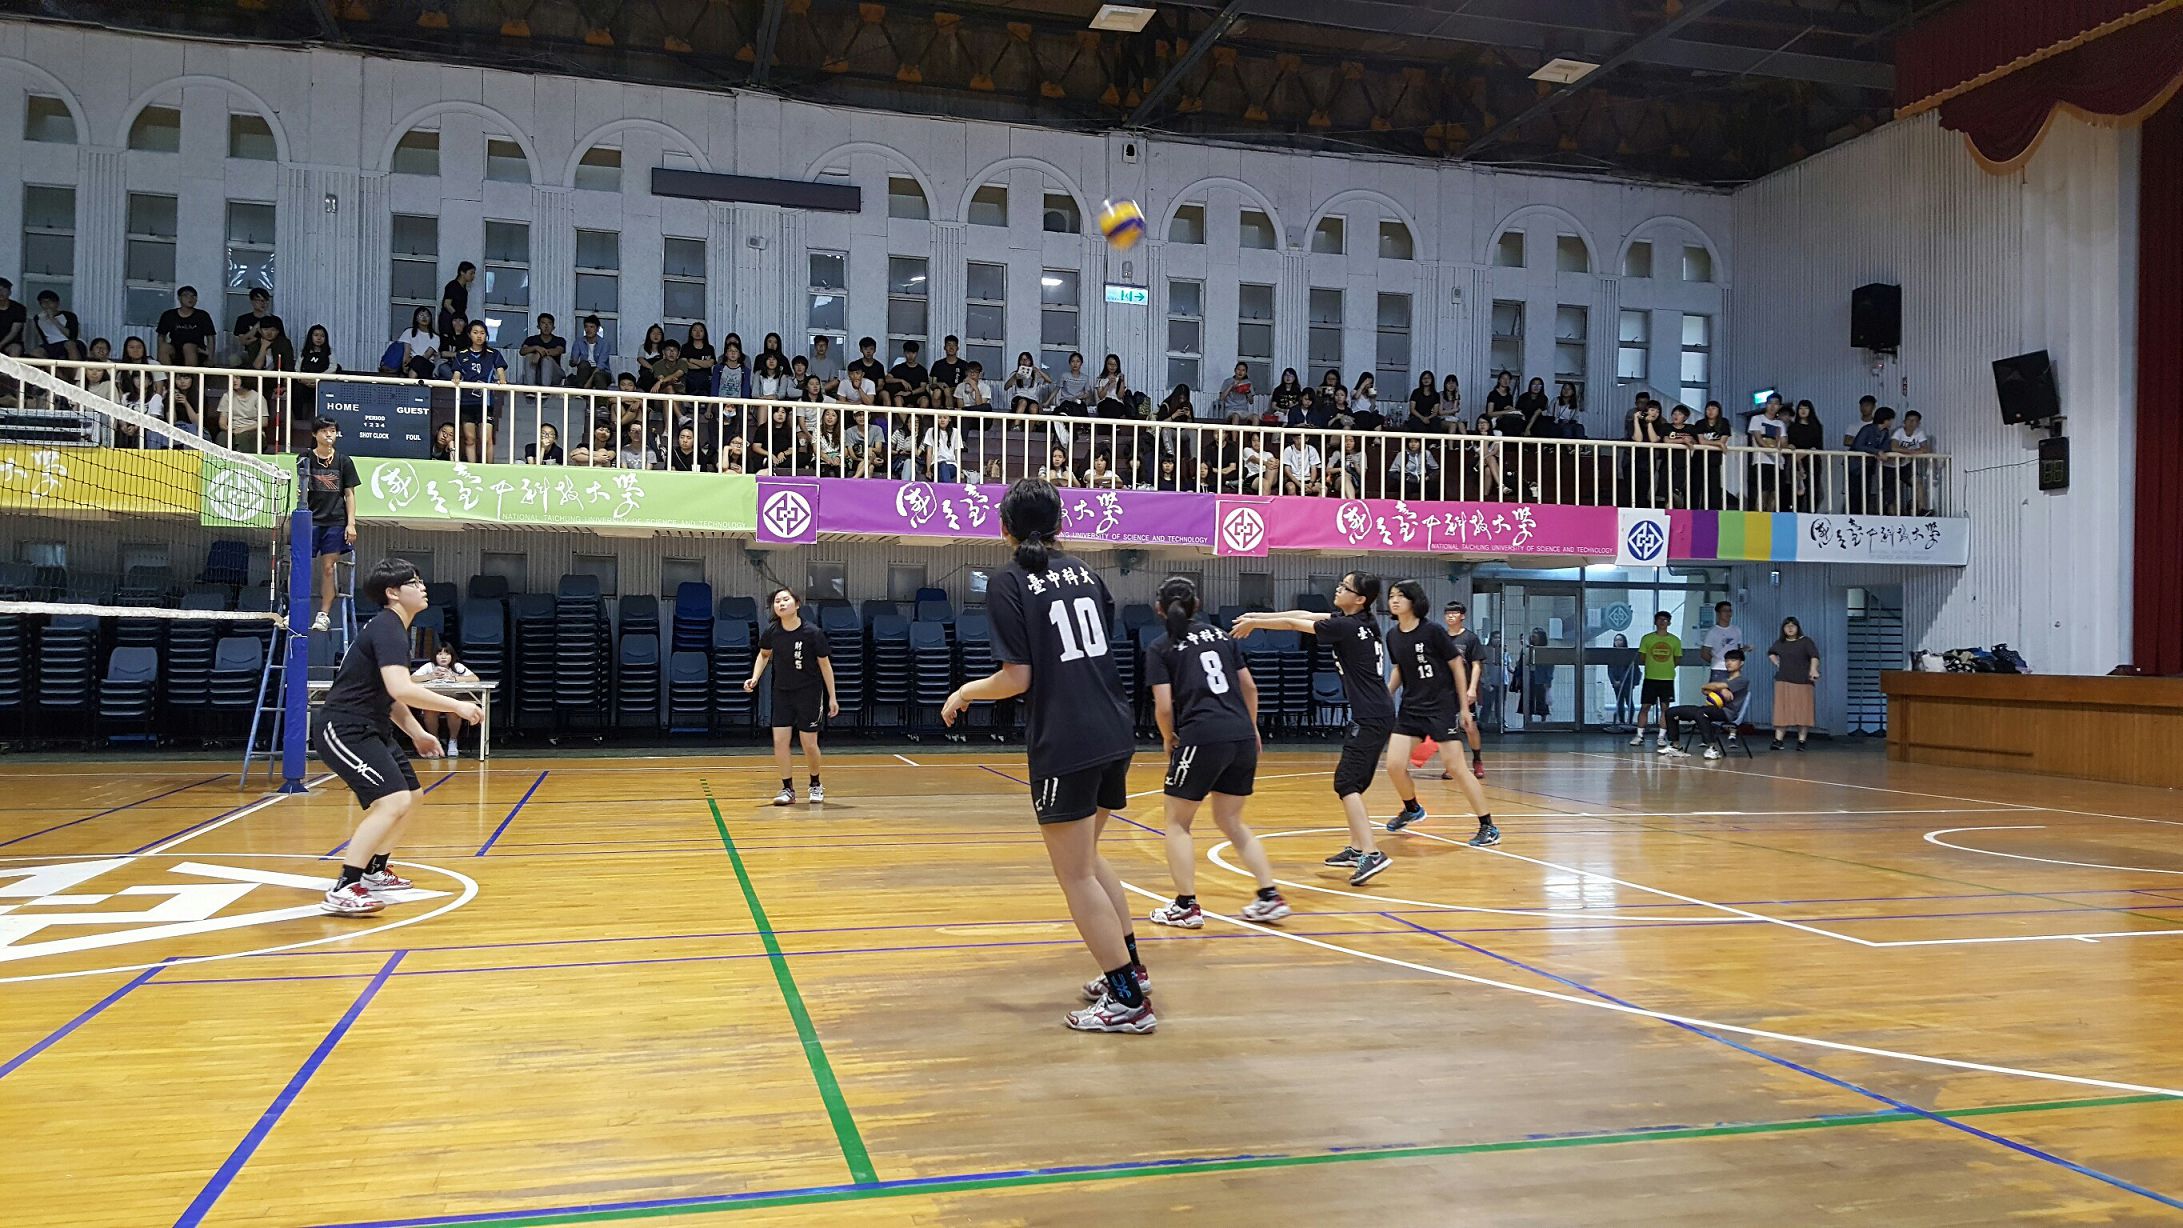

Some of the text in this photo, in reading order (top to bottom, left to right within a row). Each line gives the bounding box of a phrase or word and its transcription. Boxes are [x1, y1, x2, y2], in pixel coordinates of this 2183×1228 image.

[327, 403, 359, 412] HOME
[396, 406, 430, 415] GUEST
[359, 431, 389, 440] SHOT CLOCK
[502, 513, 538, 521] NATIONAL
[699, 520, 746, 529] TECHNOLOGY
[1073, 531, 1109, 540] UNIVERSITY
[1123, 534, 1150, 542] SCIENCE
[1167, 535, 1208, 544] TECHNOLOGY
[1462, 543, 1490, 551] TAICHUNG
[1491, 544, 1525, 552] UNIVERSITY
[1536, 545, 1561, 553] SCIENCE
[1577, 546, 1613, 554] TECHNOLOGY
[1027, 566, 1095, 595] 臺中科大
[1048, 597, 1108, 662] 10
[795, 660, 802, 669] 5
[1199, 650, 1229, 694] 8
[1417, 664, 1434, 679] 13
